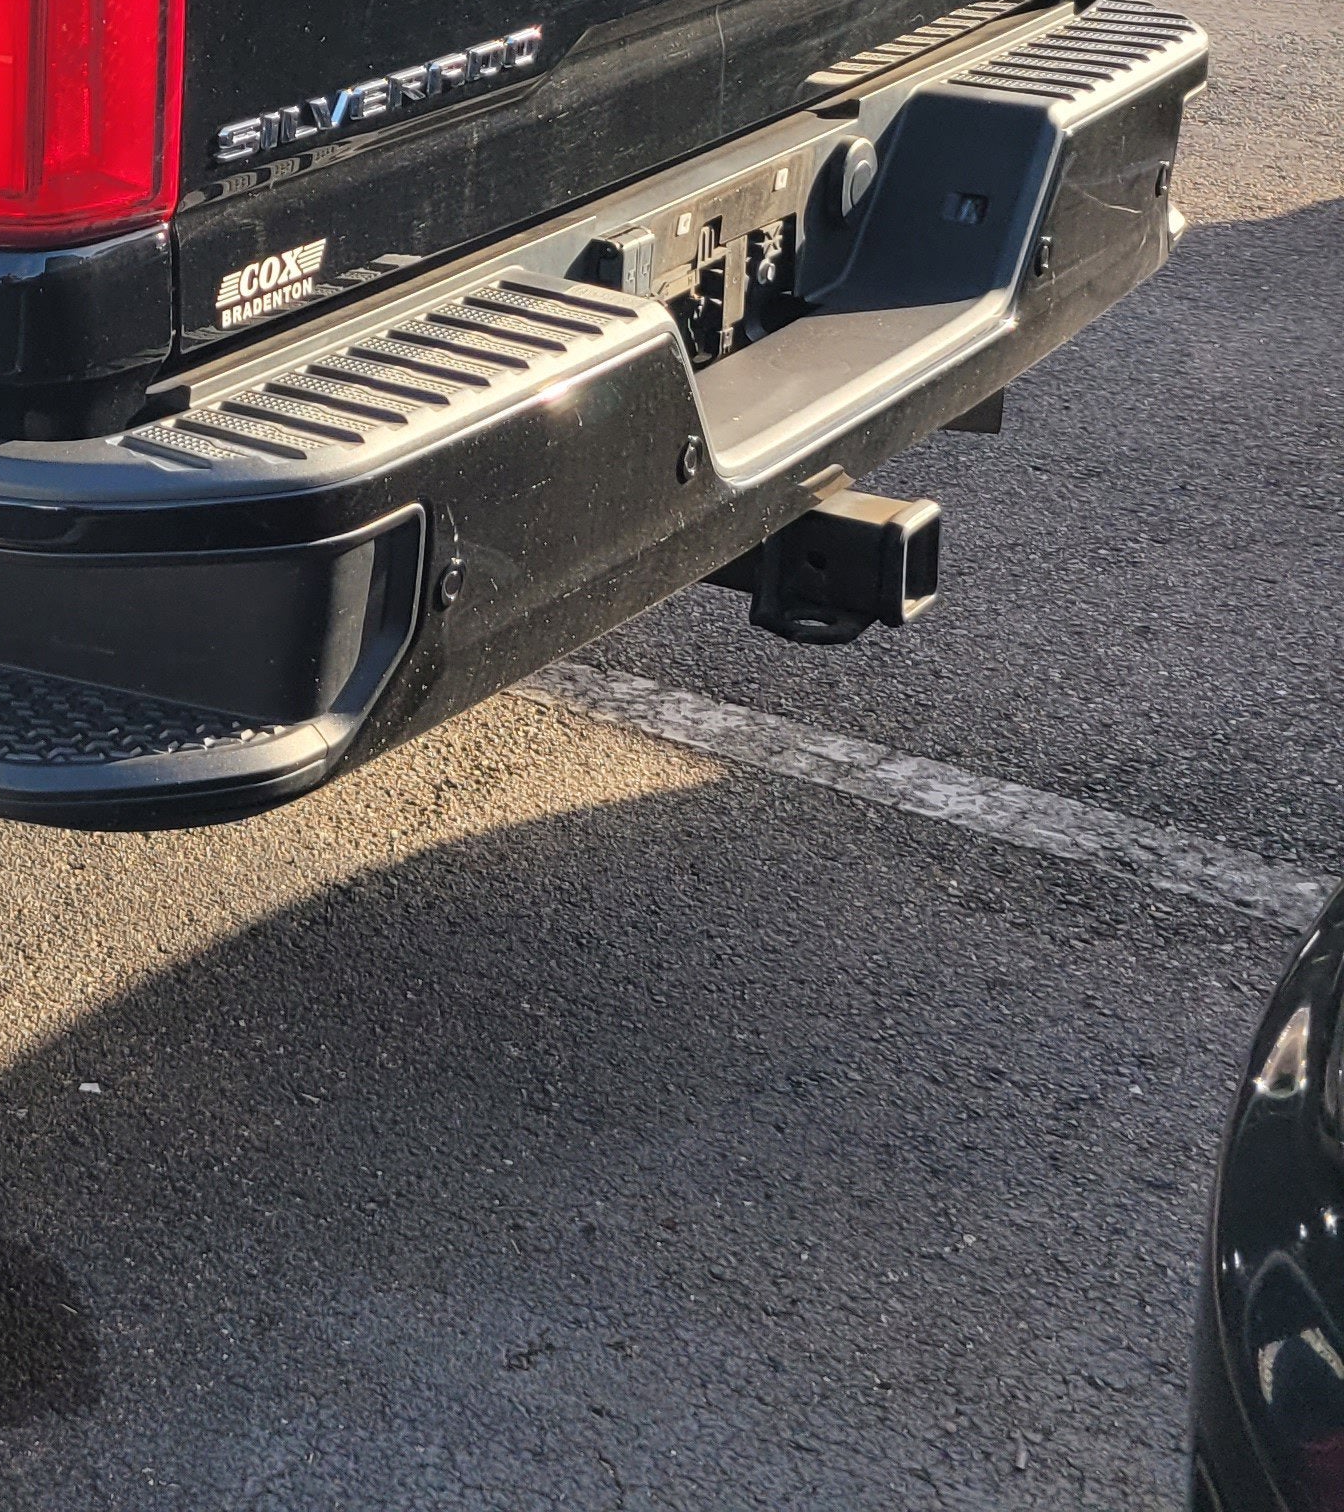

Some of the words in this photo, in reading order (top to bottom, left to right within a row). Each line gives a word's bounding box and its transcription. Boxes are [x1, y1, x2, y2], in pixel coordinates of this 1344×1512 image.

[214, 25, 543, 163] SILVERADO
[238, 249, 304, 298] COX
[221, 276, 313, 328] BRADENTON
